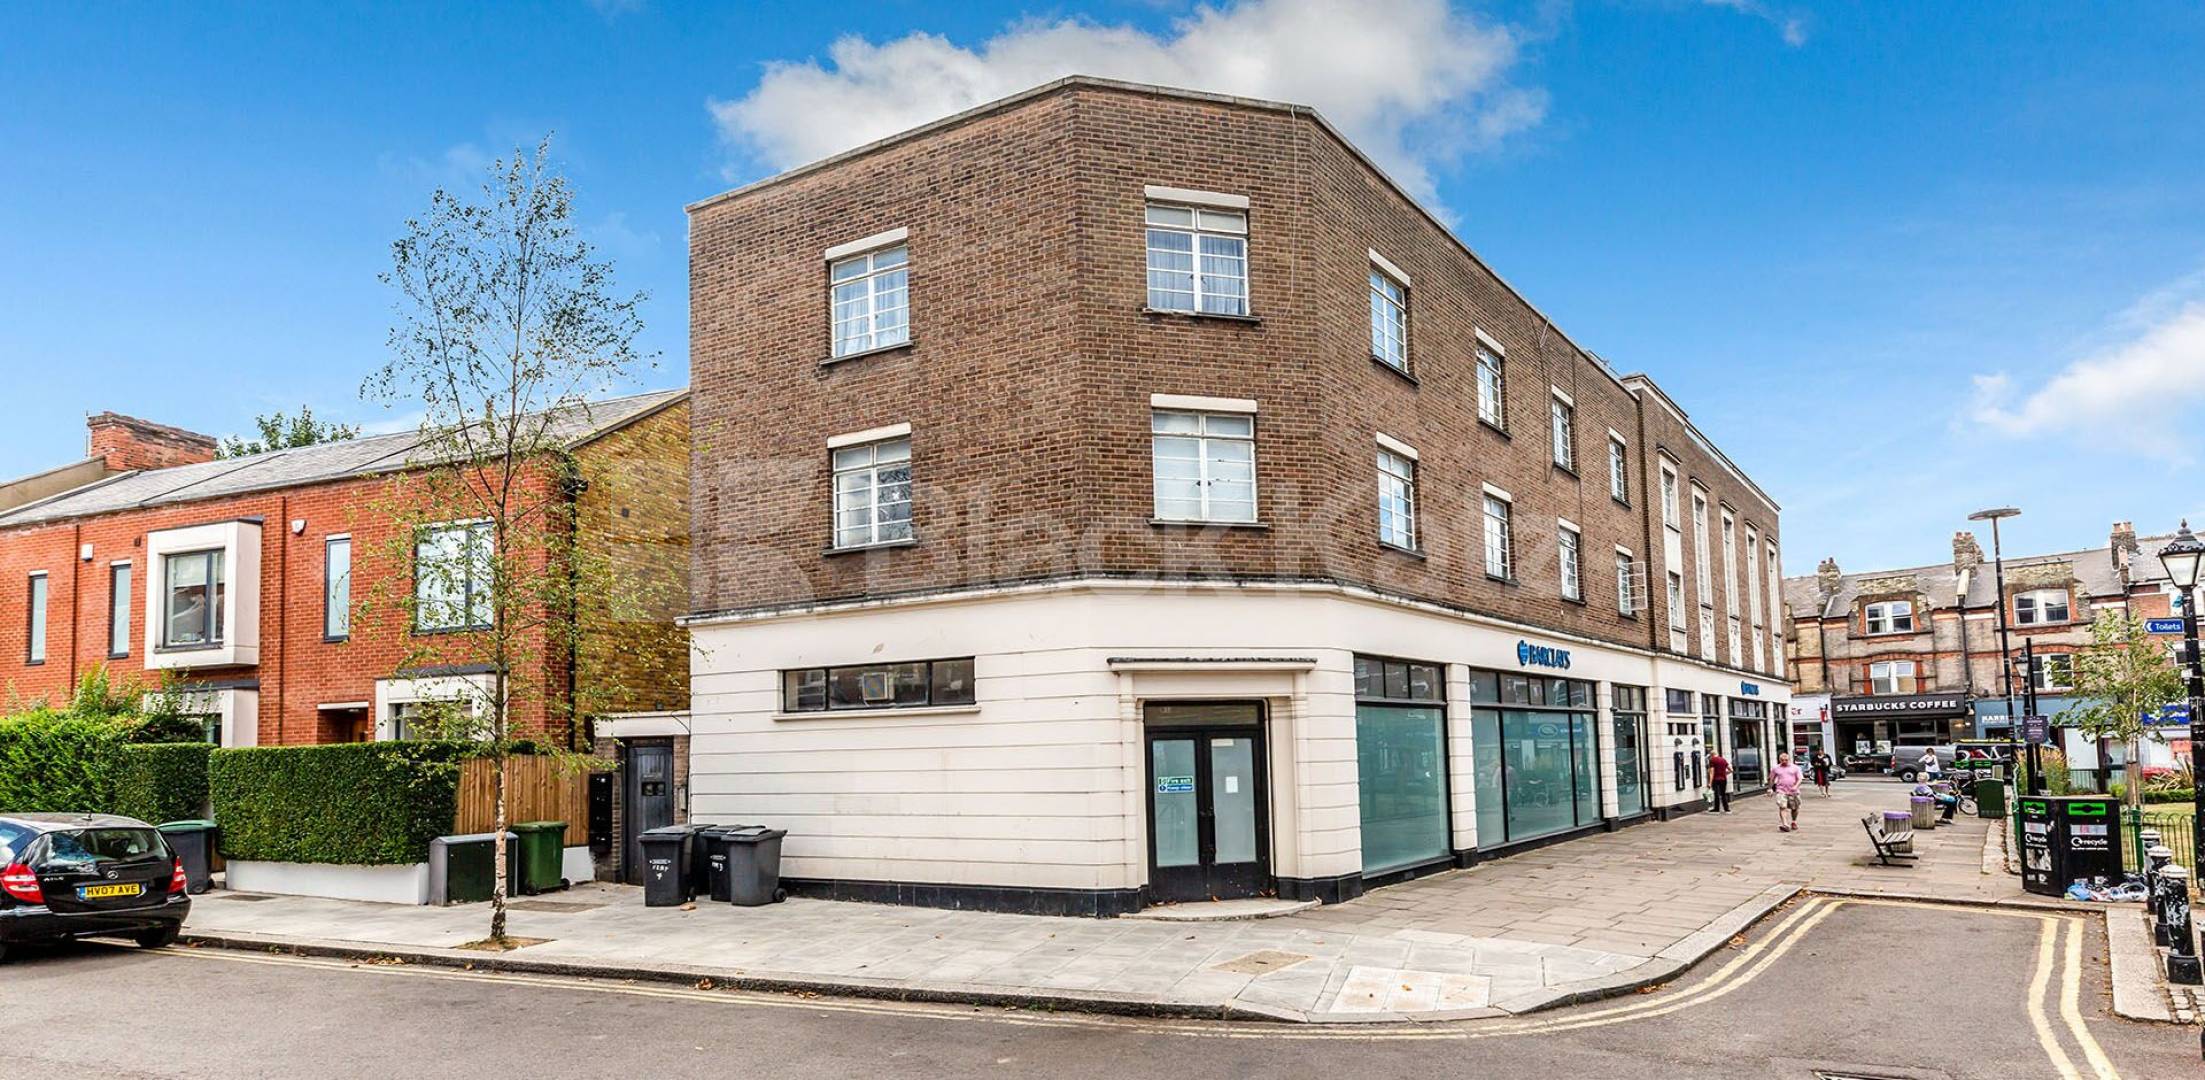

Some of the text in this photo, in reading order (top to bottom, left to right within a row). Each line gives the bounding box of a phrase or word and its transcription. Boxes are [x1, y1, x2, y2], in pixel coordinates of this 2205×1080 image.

[2155, 622, 2181, 630] Toilets
[1529, 644, 1571, 669] BARCLAYS
[1836, 700, 1957, 711] STARBUCKS COFFEE
[2083, 837, 2108, 847] recycle
[117, 885, 138, 894] AVE
